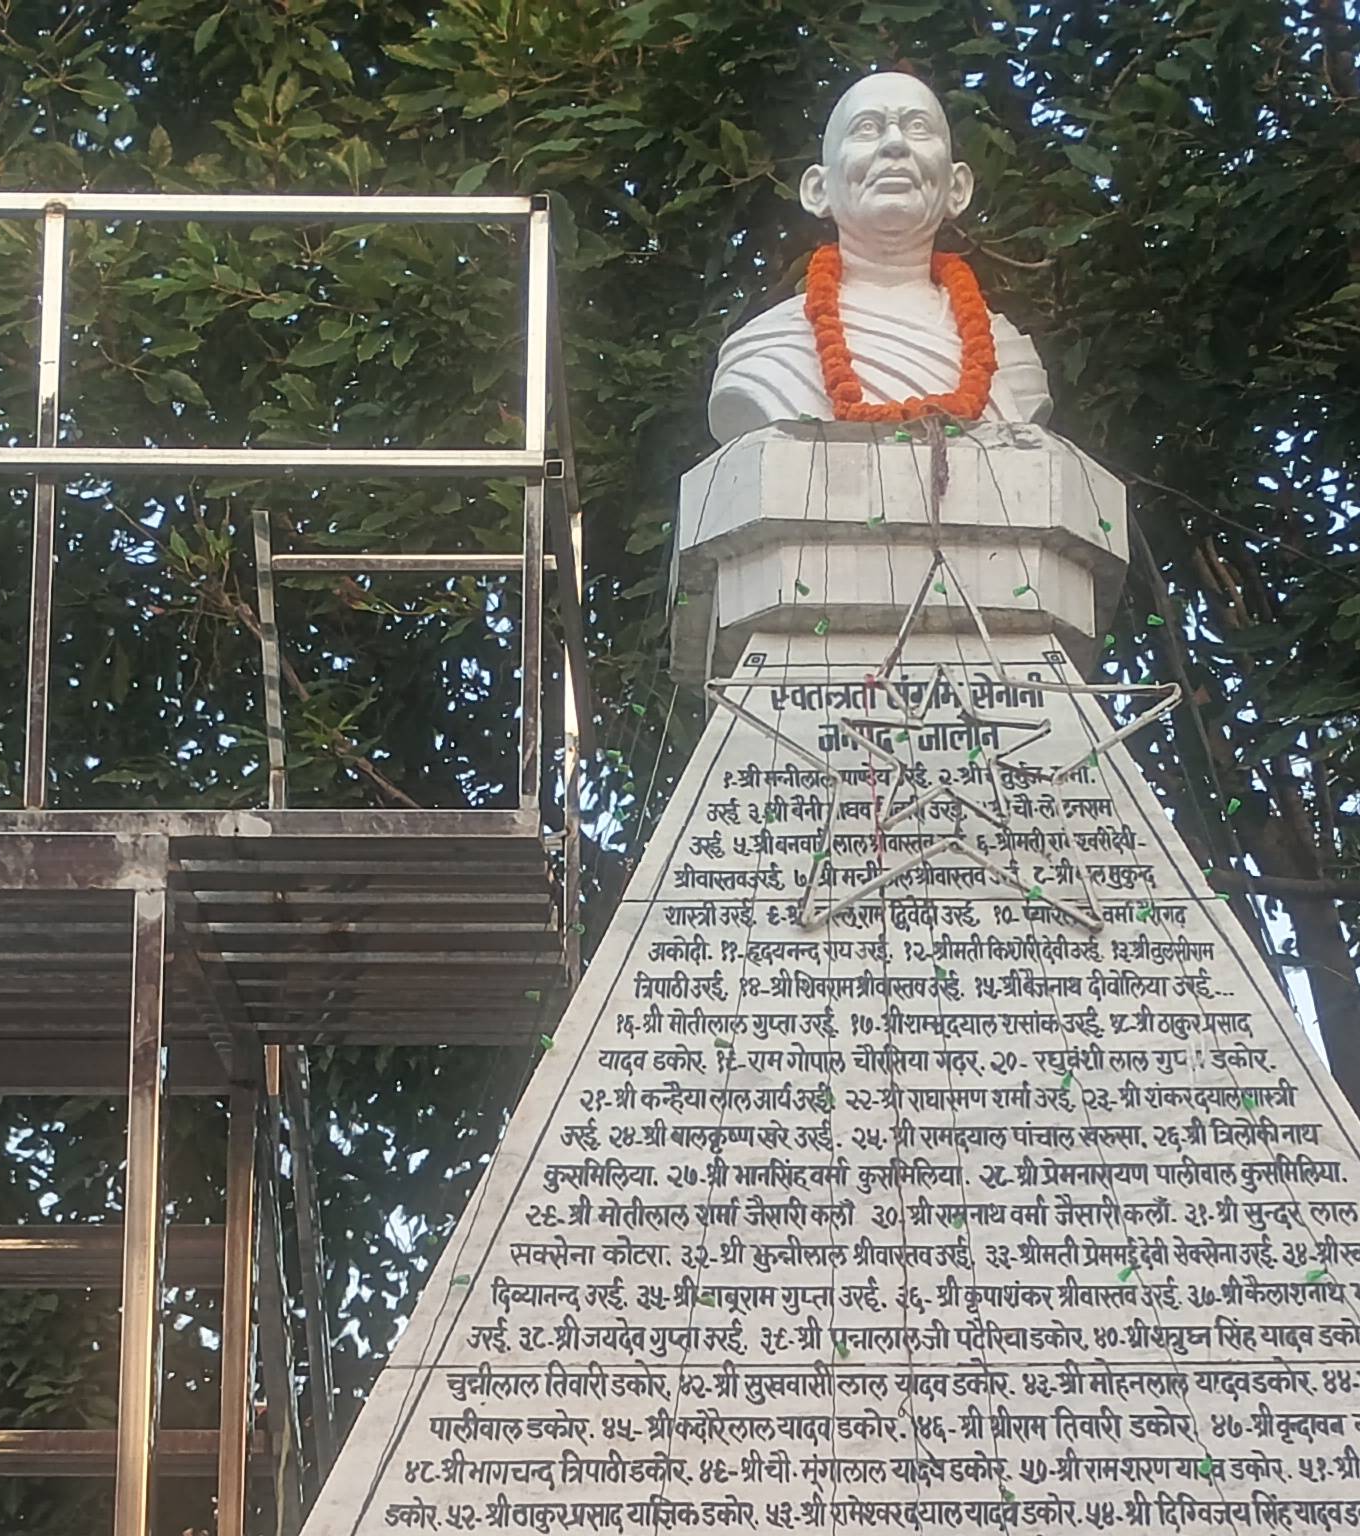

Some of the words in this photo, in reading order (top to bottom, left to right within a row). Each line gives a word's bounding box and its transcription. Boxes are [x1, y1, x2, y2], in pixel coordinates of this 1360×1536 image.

[972, 672, 1046, 710] सेनानी
[665, 899, 717, 928] शास्त्री
[823, 941, 853, 962] राय
[635, 970, 689, 999] त्रिपाठी
[795, 969, 854, 999] शिवराम
[668, 1005, 748, 1035] मोतीलाल
[752, 1013, 796, 1040] गुप्ता
[1203, 1013, 1254, 1038] प्रसाद
[598, 1050, 648, 1076] यादव
[786, 1043, 845, 1074] गोपाल
[853, 1043, 929, 1075] चौरसिया
[1034, 1042, 1104, 1073] रघुवंशी
[1109, 1049, 1148, 1072] लाल
[640, 1081, 706, 1113] कन्हैया
[992, 1081, 1031, 1110] शर्मा
[920, 1125, 1007, 1154] रामदयाल
[1012, 1120, 1075, 1149] पांचाल
[1043, 1162, 1148, 1188] प्रेमनारायण
[1155, 1155, 1236, 1187] पालीवाल
[598, 1196, 690, 1230] मोतीलाल
[695, 1197, 739, 1228] शर्मा
[1244, 1201, 1305, 1231] सुन्दर
[1310, 1201, 1359, 1226] लाल
[853, 1236, 932, 1269] श्रीवास्तव
[782, 1286, 835, 1316] गुप्ता
[1058, 1279, 1137, 1310] श्रीवास्तव
[1215, 1317, 1257, 1351] सिंह
[1261, 1325, 1314, 1355] यादव
[545, 1361, 607, 1398] तिवारी
[745, 1361, 833, 1405] सुखवासी
[839, 1373, 888, 1399] लाल
[895, 1373, 949, 1402] यादव
[430, 1408, 524, 1443] पालीवाल
[1055, 1405, 1121, 1443] तिवारी
[1252, 1491, 1292, 1528] सिंह
